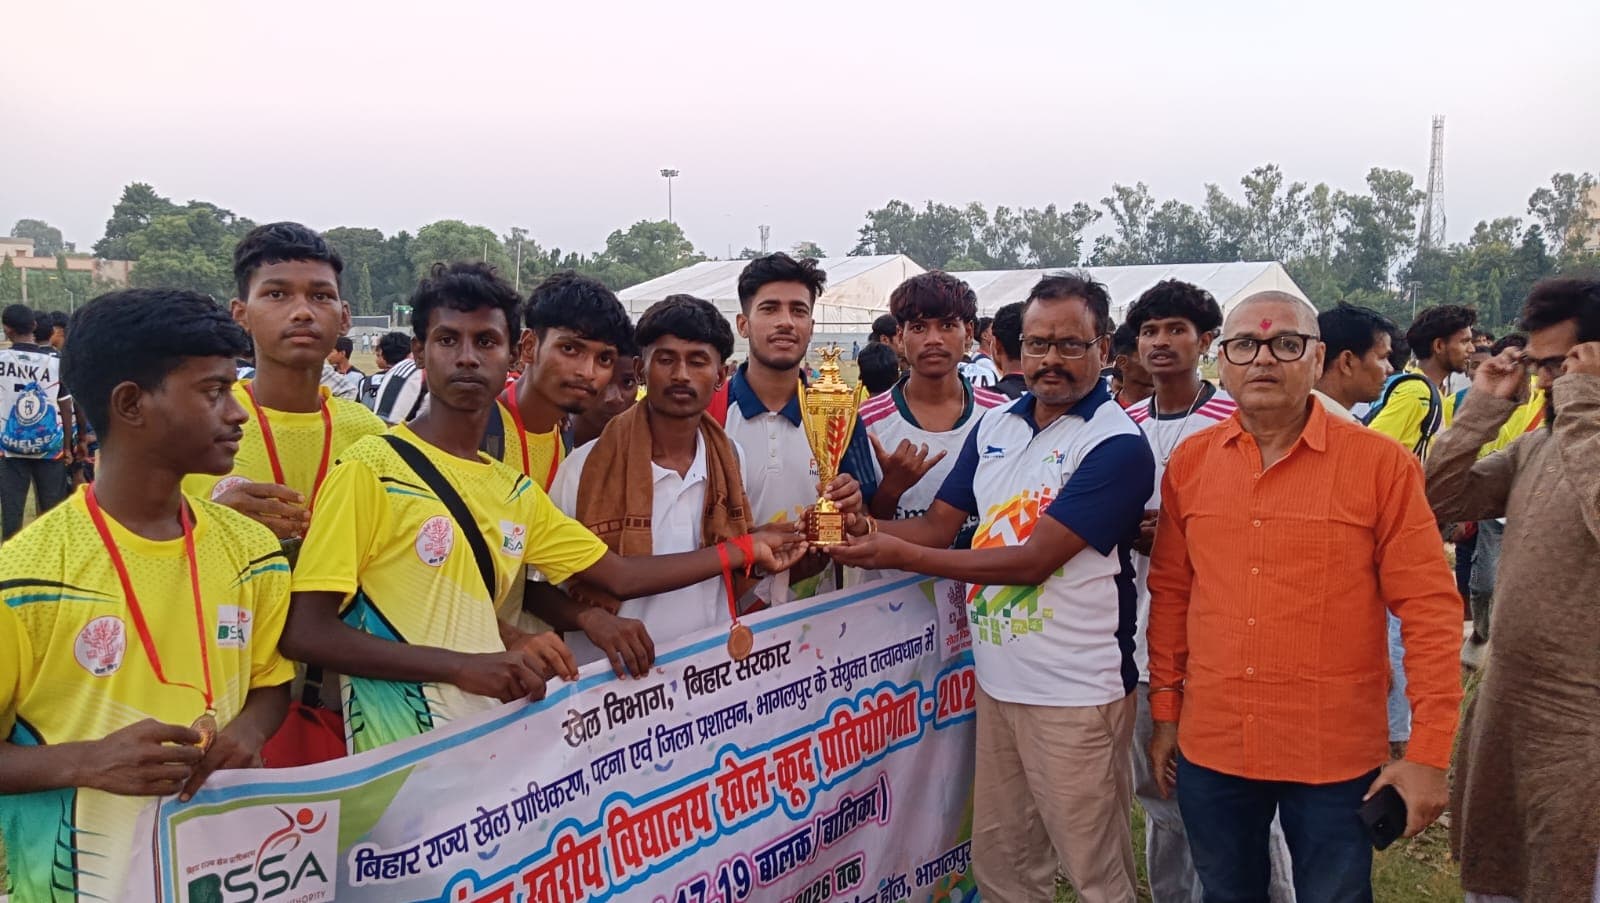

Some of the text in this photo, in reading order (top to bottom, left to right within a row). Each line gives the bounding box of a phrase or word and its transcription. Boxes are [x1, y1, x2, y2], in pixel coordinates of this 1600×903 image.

[0, 361, 50, 382] BANKA
[561, 641, 791, 748] खेल विभाग, बिहार सरकार
[355, 845, 420, 882] बिहार
[423, 823, 469, 869] राज्य
[470, 804, 511, 846] खेल
[511, 769, 590, 831] प्राधिकरण,
[591, 748, 626, 785] पटना
[629, 728, 653, 769] एवं
[655, 722, 694, 758] जिला
[696, 700, 753, 744] प्रशासन,
[757, 676, 813, 717] भागलपुर
[813, 666, 827, 695] के
[829, 656, 867, 692] संयुक्त
[924, 624, 935, 651] में
[607, 783, 713, 876] विद्यालय
[716, 737, 816, 821] खेल-कूद
[818, 691, 919, 778] प्रतियोगिता
[938, 669, 976, 720] 202
[188, 851, 328, 903] BSSA
[835, 857, 861, 891] तक
[916, 840, 971, 886] भागलपुर
